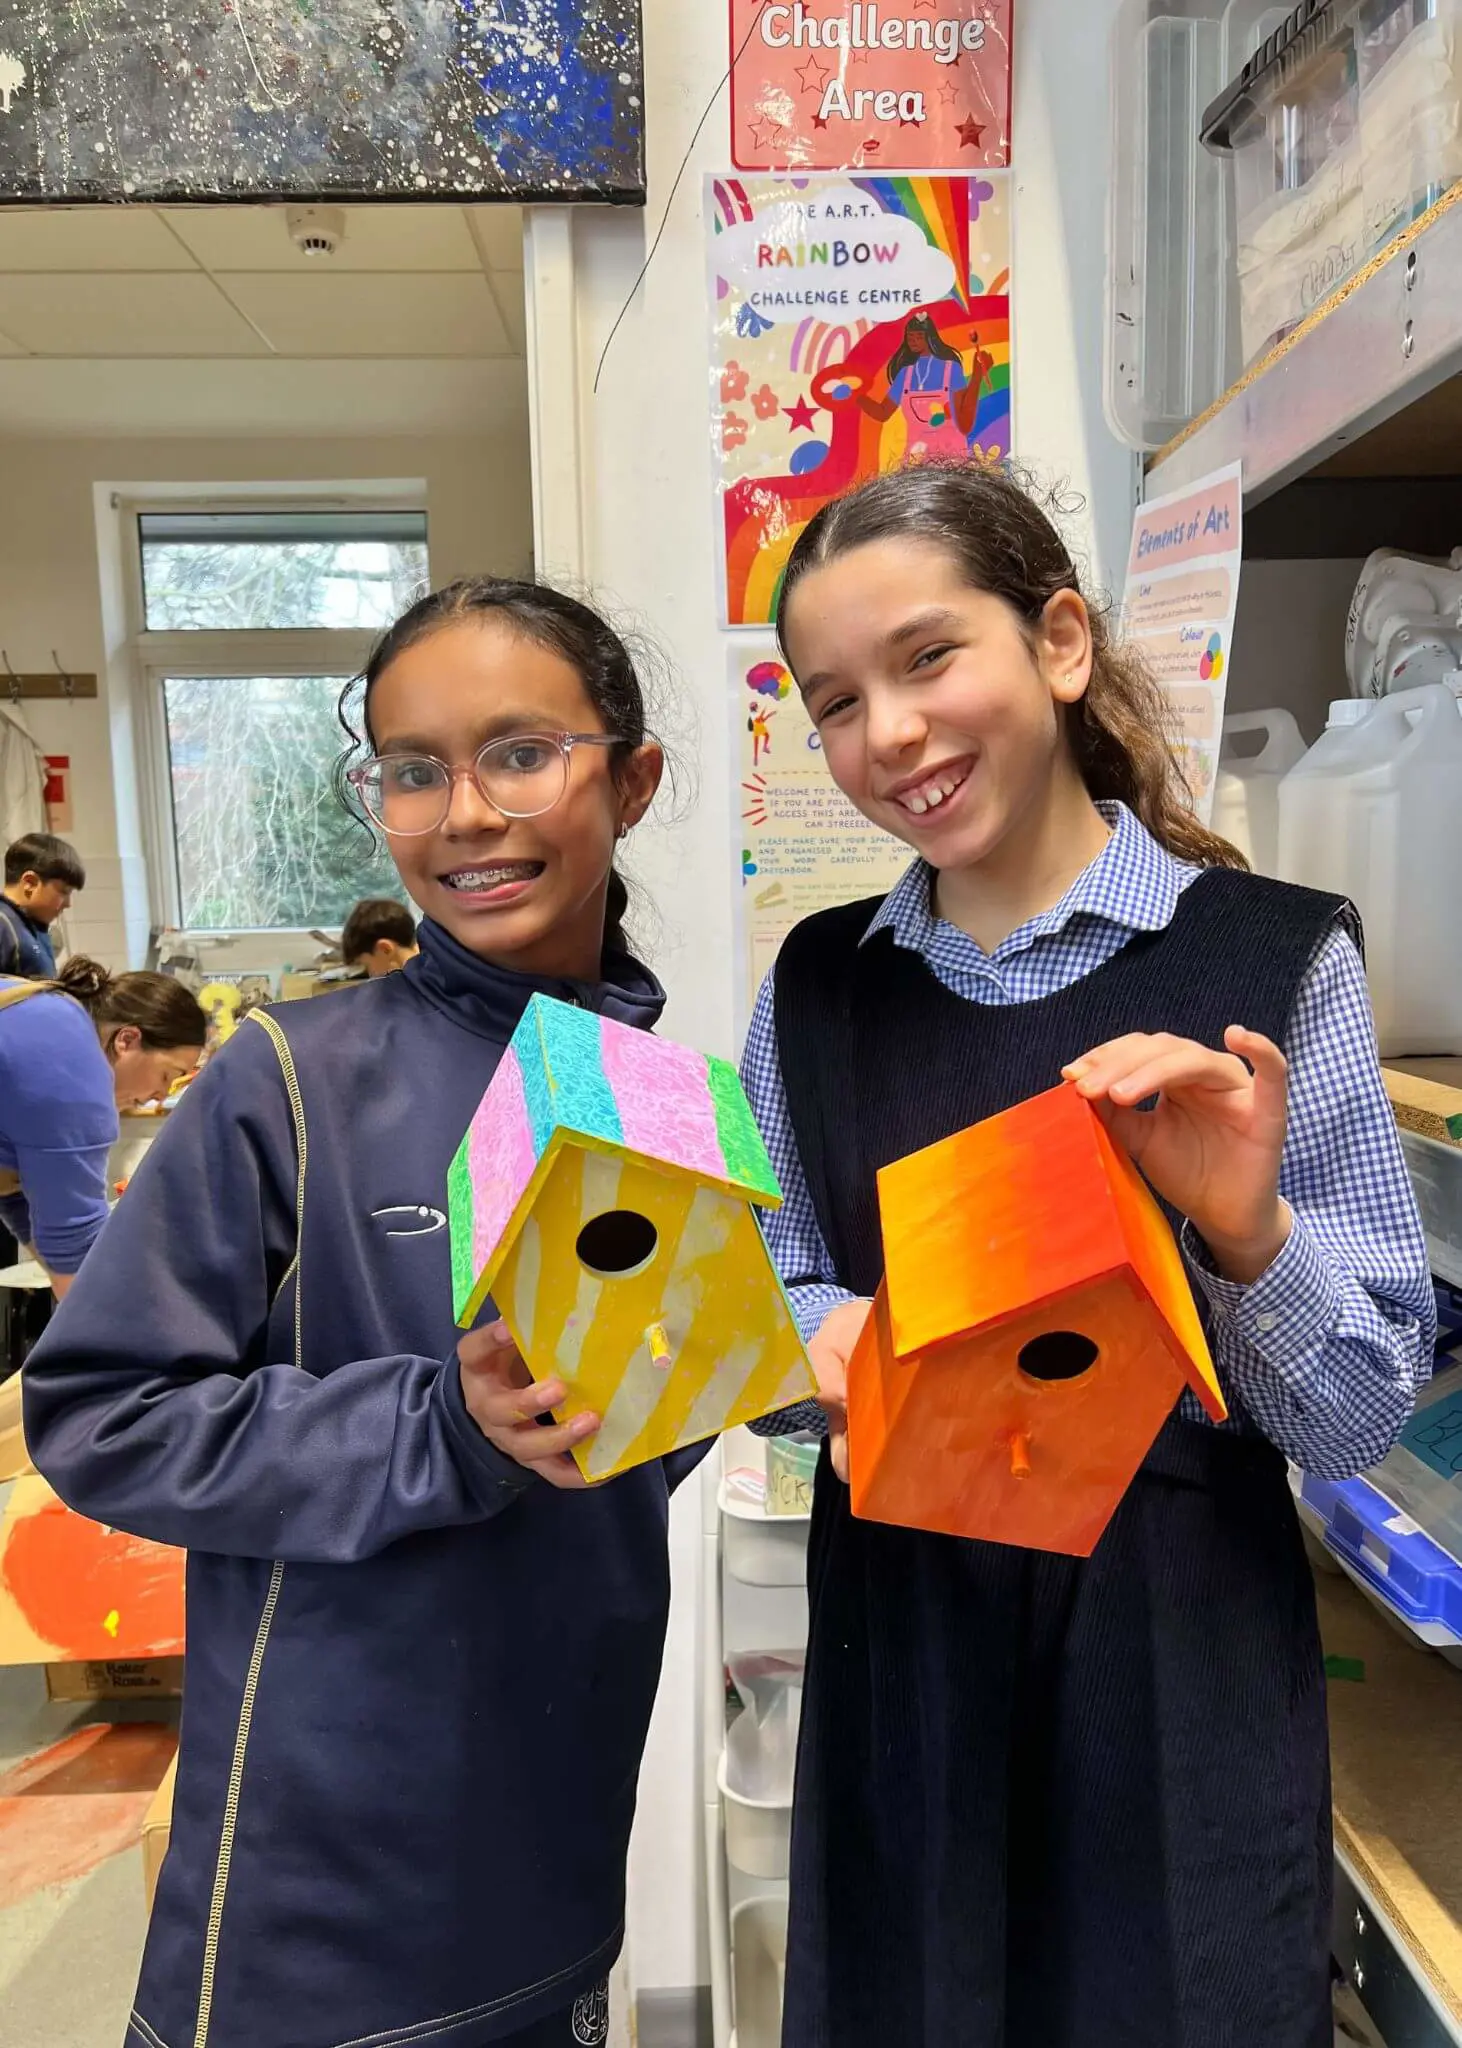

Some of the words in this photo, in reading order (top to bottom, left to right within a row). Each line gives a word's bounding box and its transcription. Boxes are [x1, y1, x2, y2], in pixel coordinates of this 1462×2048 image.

[759, 3, 986, 64] Challenge
[818, 79, 927, 122] Area
[825, 204, 875, 218] A.R.T.
[757, 240, 900, 268] RAINBOW
[750, 289, 849, 305] CHALLENGE
[858, 288, 923, 304] CENTRE
[1137, 521, 1185, 559] Elements
[1187, 509, 1201, 541] of
[1203, 504, 1230, 535] Art
[1179, 627, 1205, 643] Colour
[765, 788, 809, 797] WELCOME
[814, 788, 826, 796] TO
[784, 799, 801, 807] YOU
[806, 799, 824, 807] ARE
[774, 810, 808, 818] ACCESS
[812, 810, 834, 818] THIS
[759, 838, 787, 846] PLEASE
[792, 837, 815, 845] MAKE
[845, 836, 866, 844] YOUR
[871, 836, 896, 844] SPACE
[784, 847, 832, 855] ORGANISED
[840, 846, 858, 854] AND
[830, 856, 876, 864] CAREFULLY
